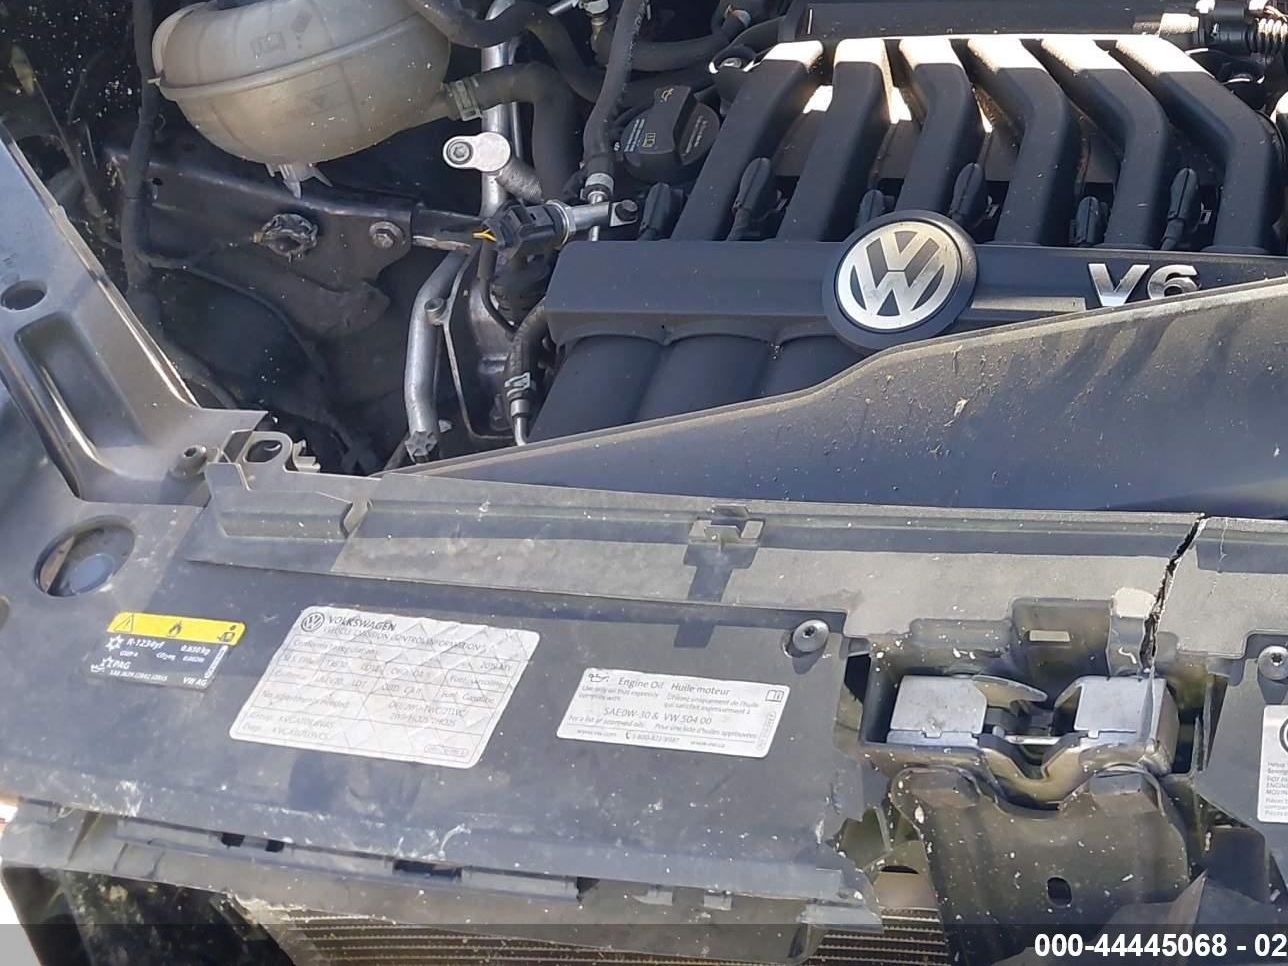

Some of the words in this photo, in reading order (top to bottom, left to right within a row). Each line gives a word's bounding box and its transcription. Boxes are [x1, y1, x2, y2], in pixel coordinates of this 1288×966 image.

[1088, 263, 1201, 307] V6
[328, 615, 397, 631] VOLKSWAGEN
[126, 638, 165, 650] R-1234yf
[112, 659, 132, 669] PAG
[182, 677, 196, 685] VW
[195, 678, 207, 687] AG
[618, 677, 649, 689] Engine
[650, 681, 664, 689] Oil
[671, 682, 695, 692] Huile
[696, 686, 731, 696] moteur
[651, 712, 660, 720] &
[664, 712, 681, 722] VW
[680, 714, 698, 724] 504
[699, 716, 712, 725] 00
